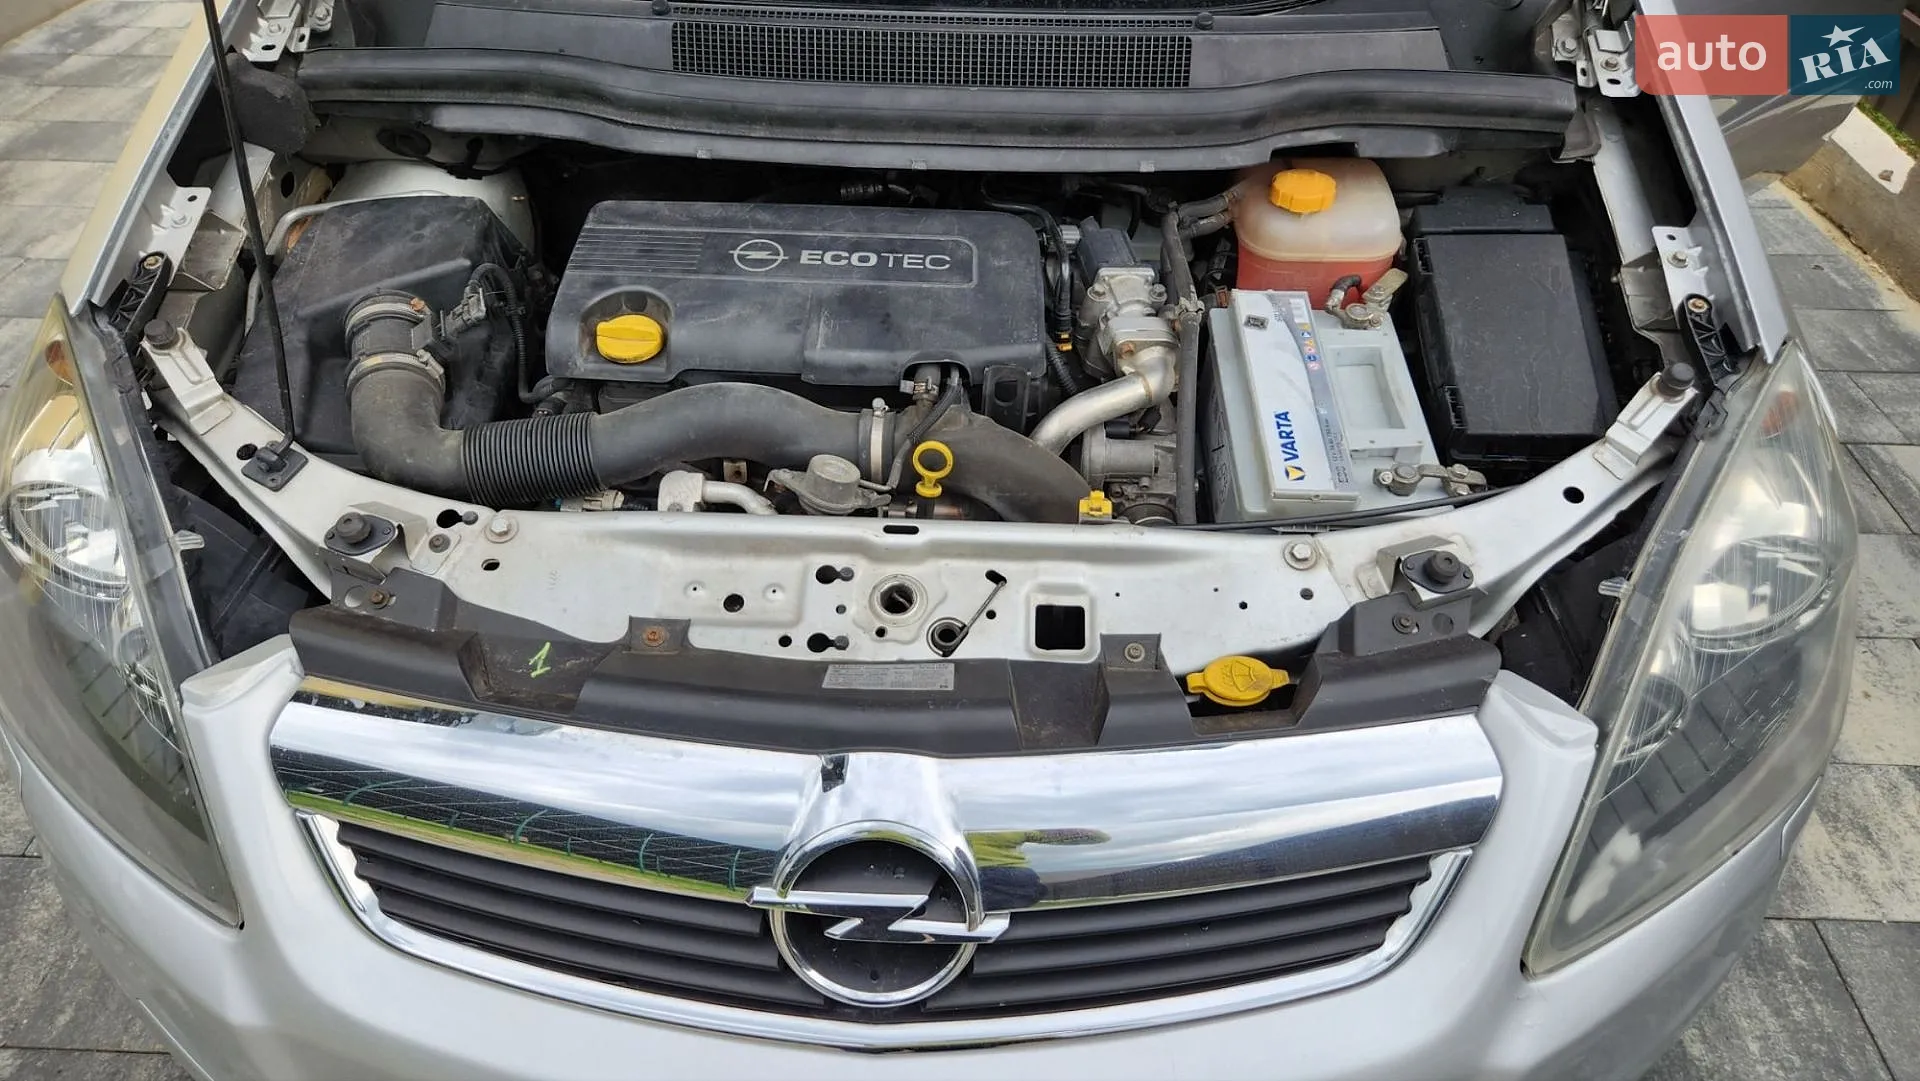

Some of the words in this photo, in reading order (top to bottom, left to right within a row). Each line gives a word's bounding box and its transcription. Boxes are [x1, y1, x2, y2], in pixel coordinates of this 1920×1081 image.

[800, 250, 951, 271] ECOTEC
[1274, 411, 1299, 462] VARTA
[529, 641, 551, 678] 1
